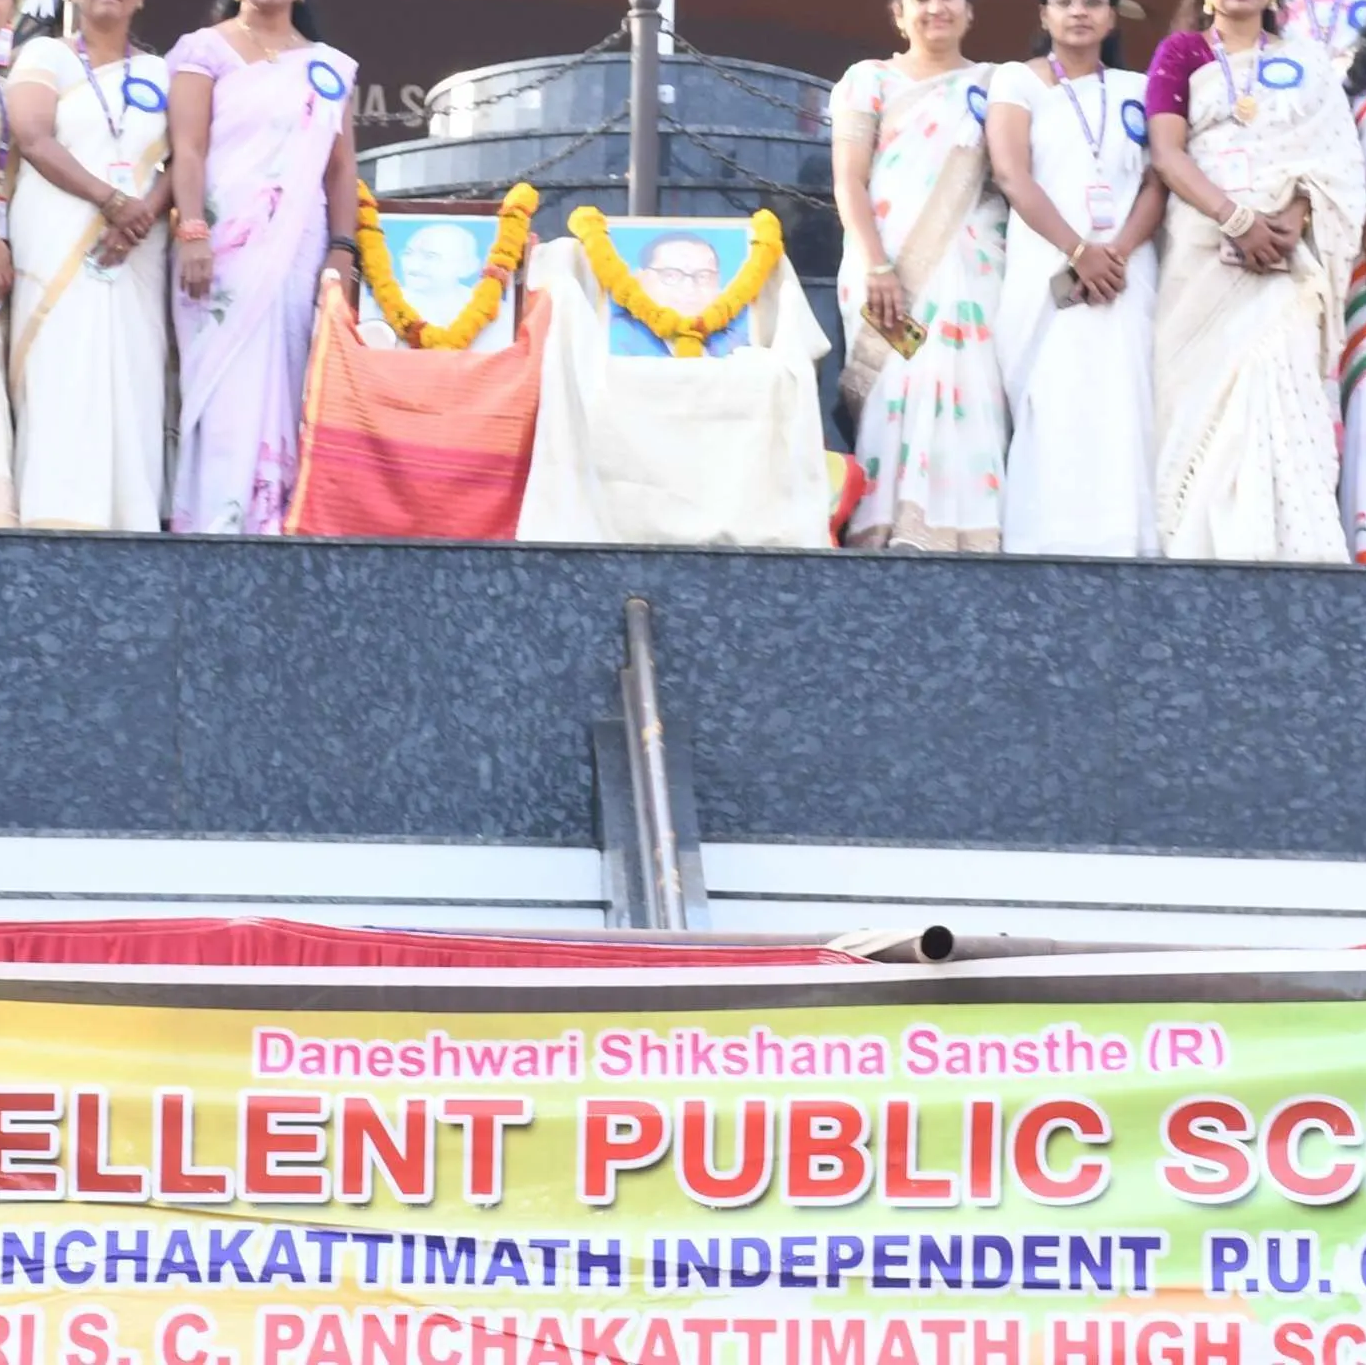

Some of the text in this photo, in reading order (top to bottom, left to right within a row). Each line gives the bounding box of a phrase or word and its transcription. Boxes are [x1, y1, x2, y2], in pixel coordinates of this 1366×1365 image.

[258, 1027, 1225, 1077] Daneshwari Shikshana Sansthe (R)
[581, 1099, 1106, 1201] PUBLIC
[652, 1234, 1163, 1291] INDEPENDENT
[1210, 1237, 1332, 1294] P.U.
[263, 1312, 1020, 1365] PANCHAKATTIMATH
[1052, 1320, 1241, 1365] HIGH
